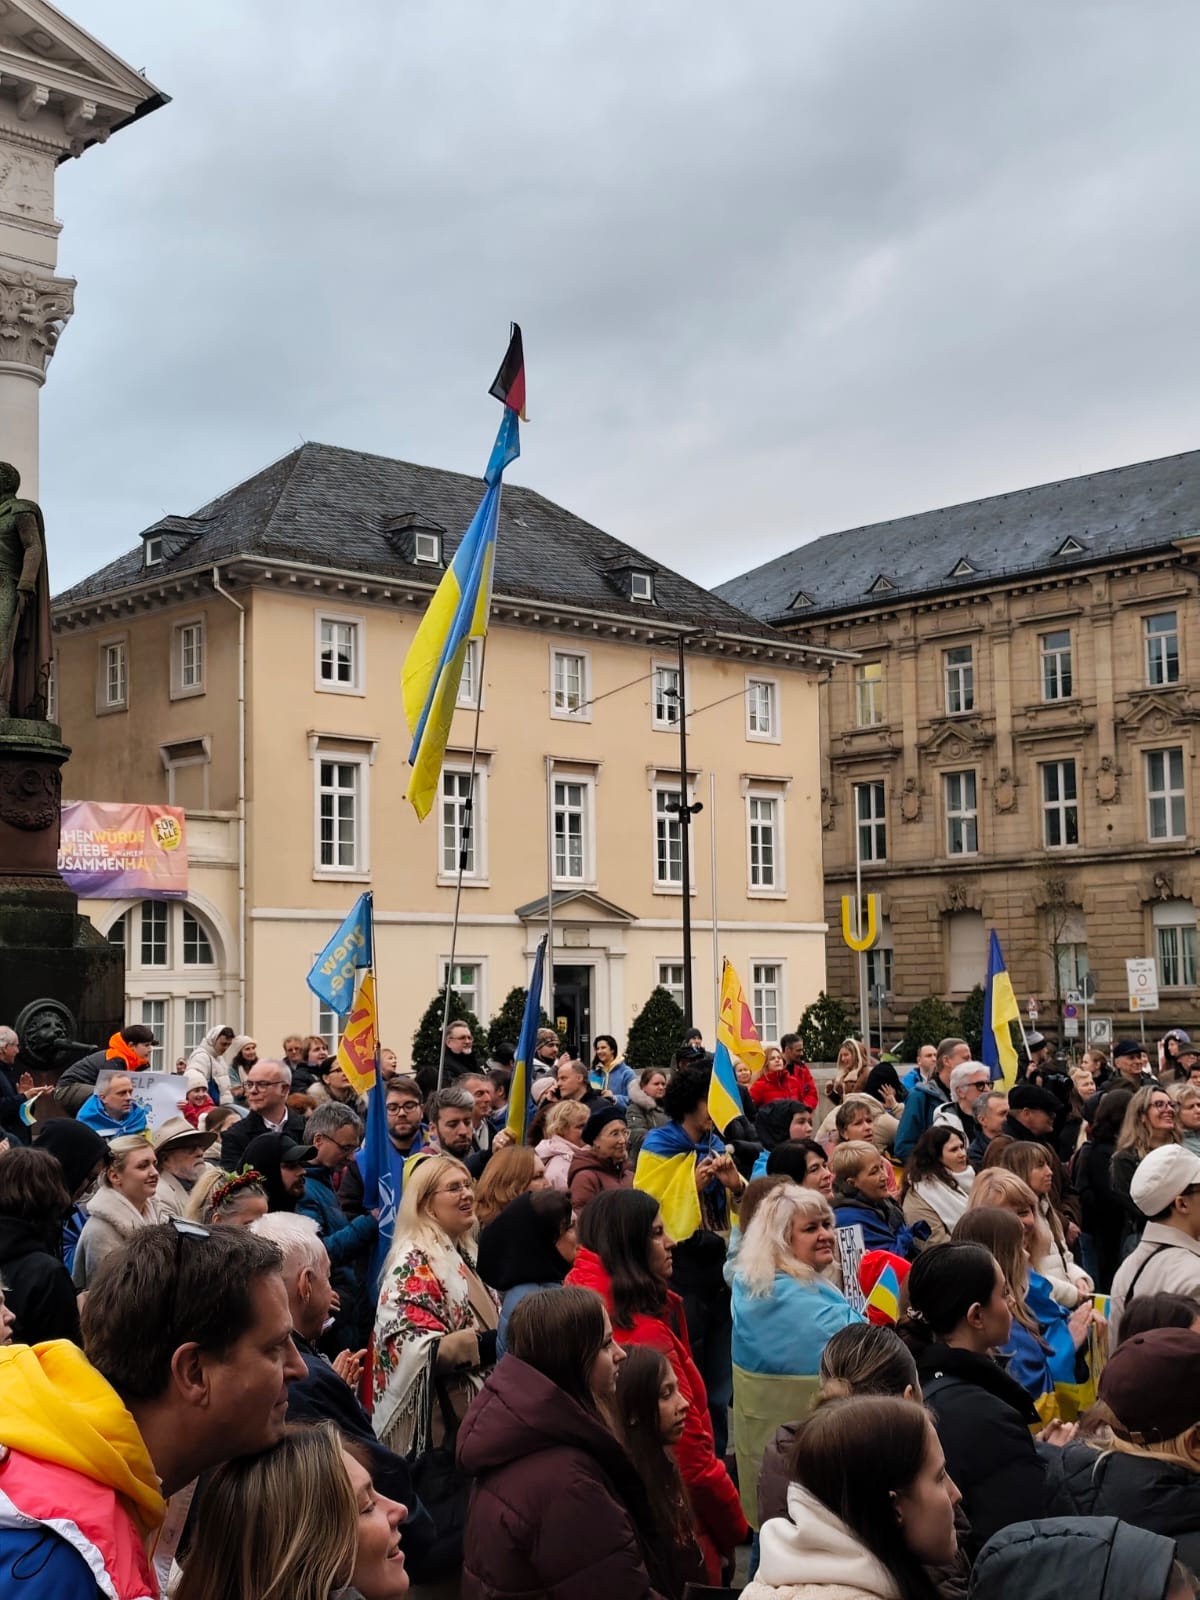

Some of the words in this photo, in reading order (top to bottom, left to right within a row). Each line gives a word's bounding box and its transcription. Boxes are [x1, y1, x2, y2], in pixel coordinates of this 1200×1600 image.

[157, 826, 179, 842] ALLE
[841, 893, 881, 952] U
[131, 1078, 154, 1089] ELP
